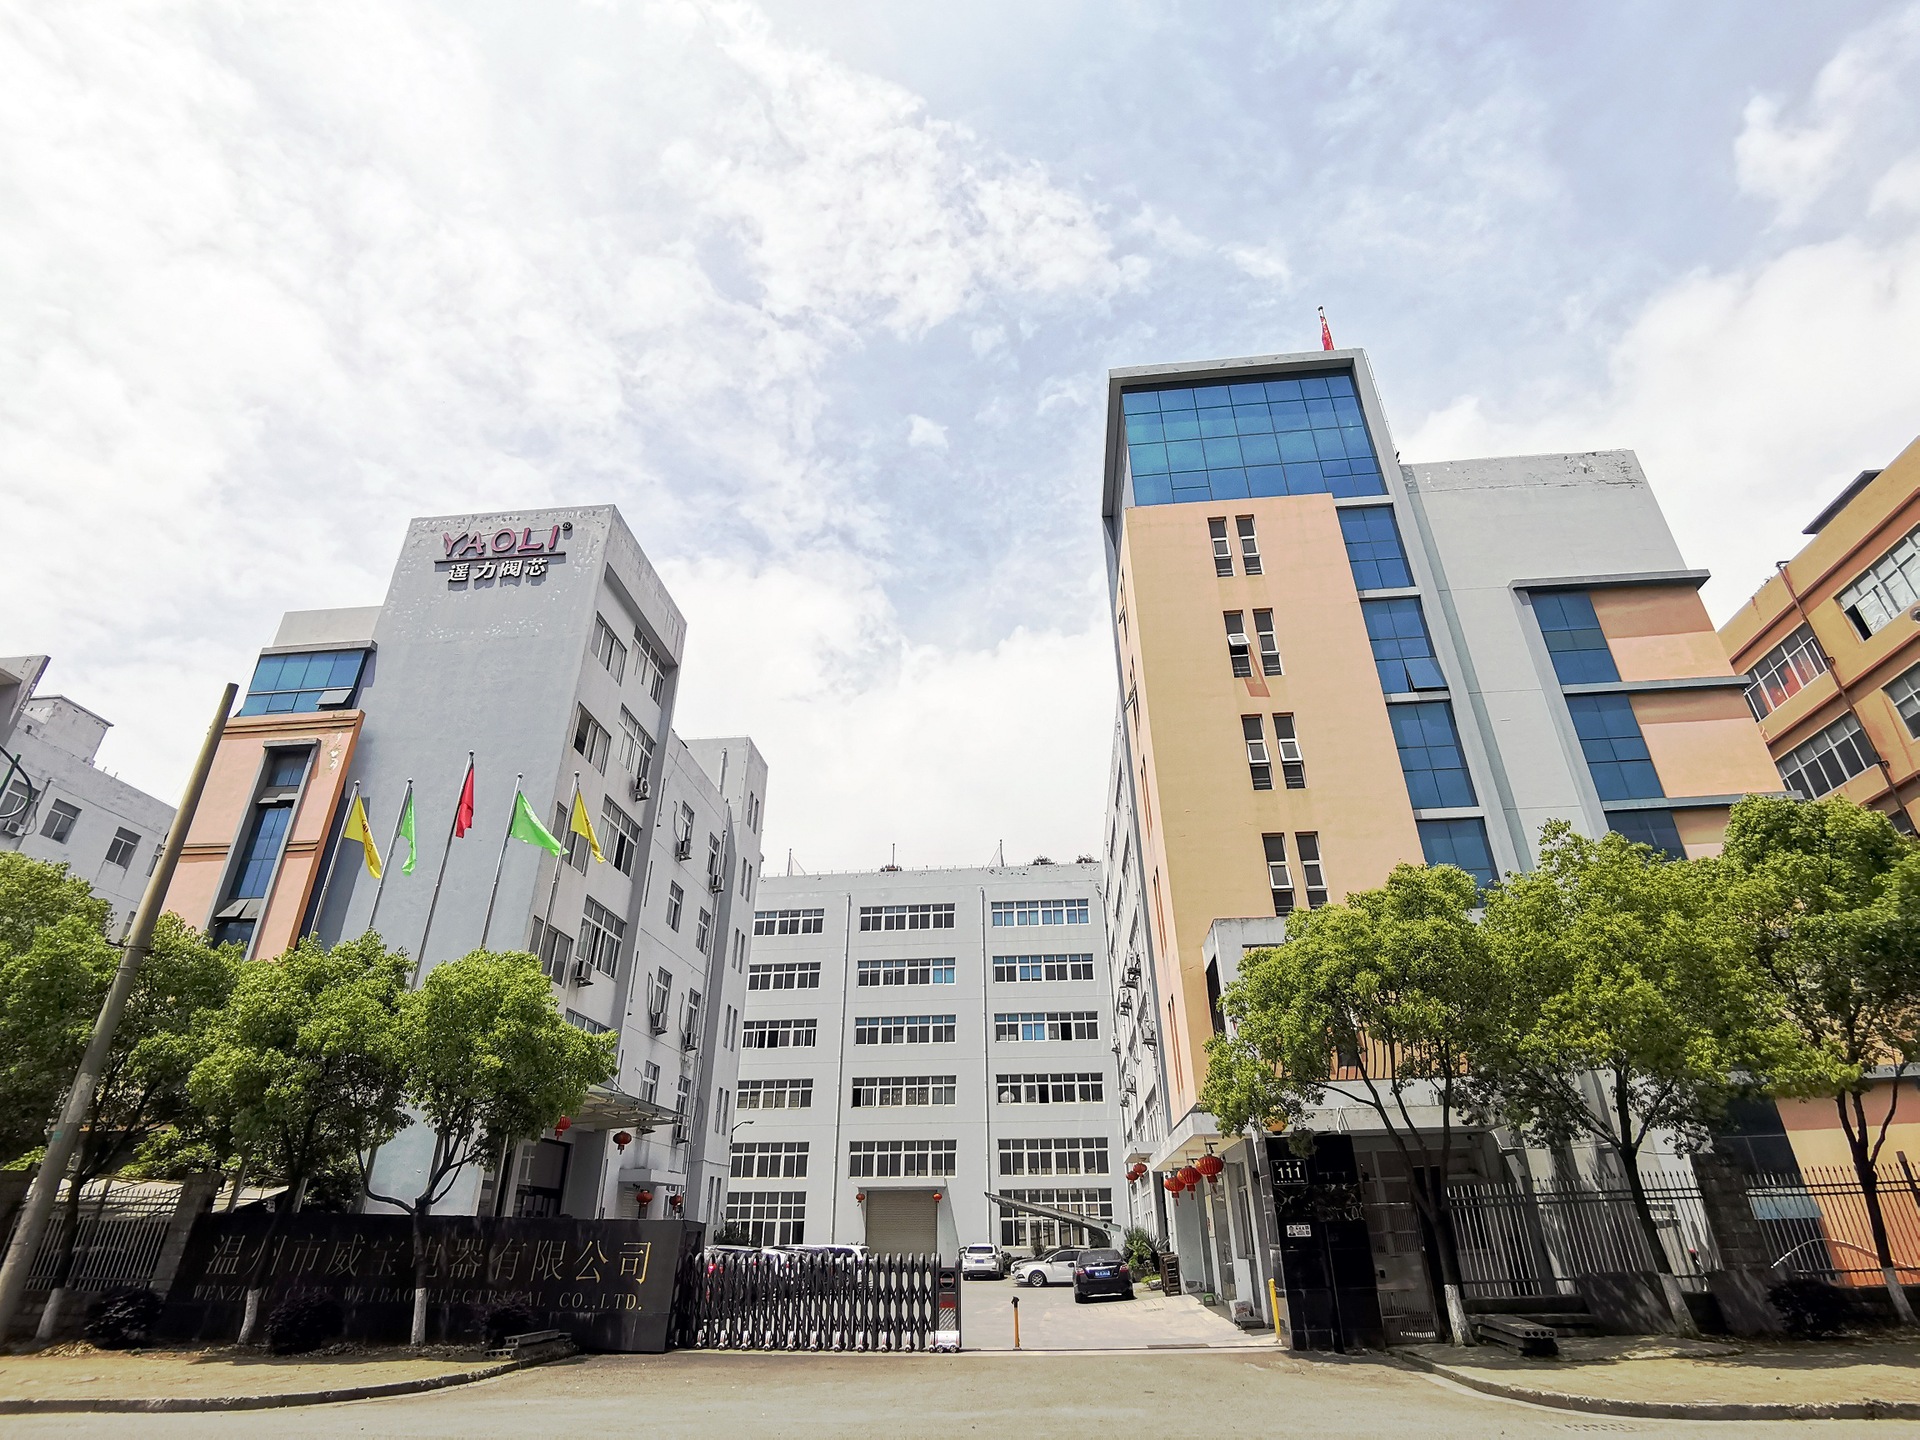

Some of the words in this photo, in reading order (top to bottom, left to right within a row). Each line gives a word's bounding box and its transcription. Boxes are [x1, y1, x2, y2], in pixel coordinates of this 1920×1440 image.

[448, 558, 549, 582] 遥力阀芯
[1277, 1166, 1301, 1179] 111
[343, 1286, 415, 1303] WEIBAO
